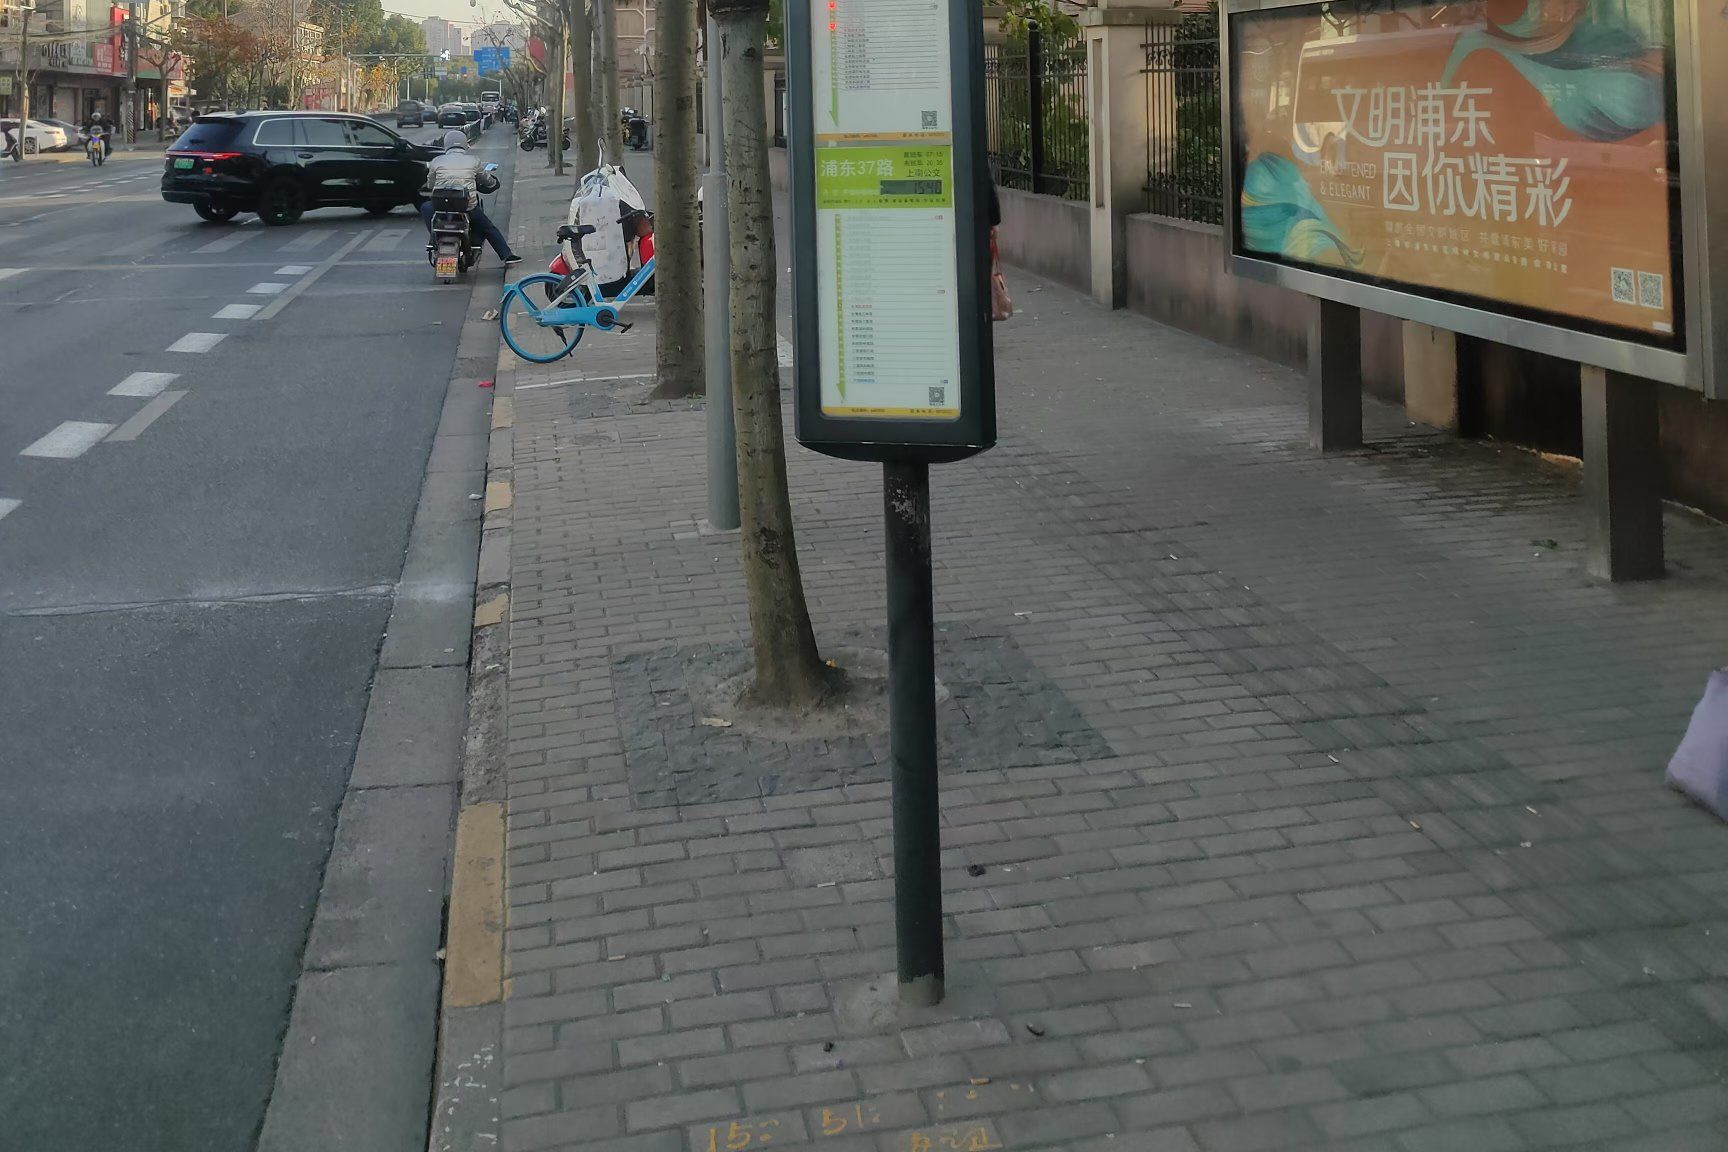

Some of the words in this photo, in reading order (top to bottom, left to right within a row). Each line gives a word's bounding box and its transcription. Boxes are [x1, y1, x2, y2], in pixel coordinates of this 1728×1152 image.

[1331, 81, 1496, 148] 文明浦东
[821, 158, 894, 177] 浦东37路
[1329, 184, 1371, 201] ELEGANT
[1383, 151, 1573, 228] 因你精彩
